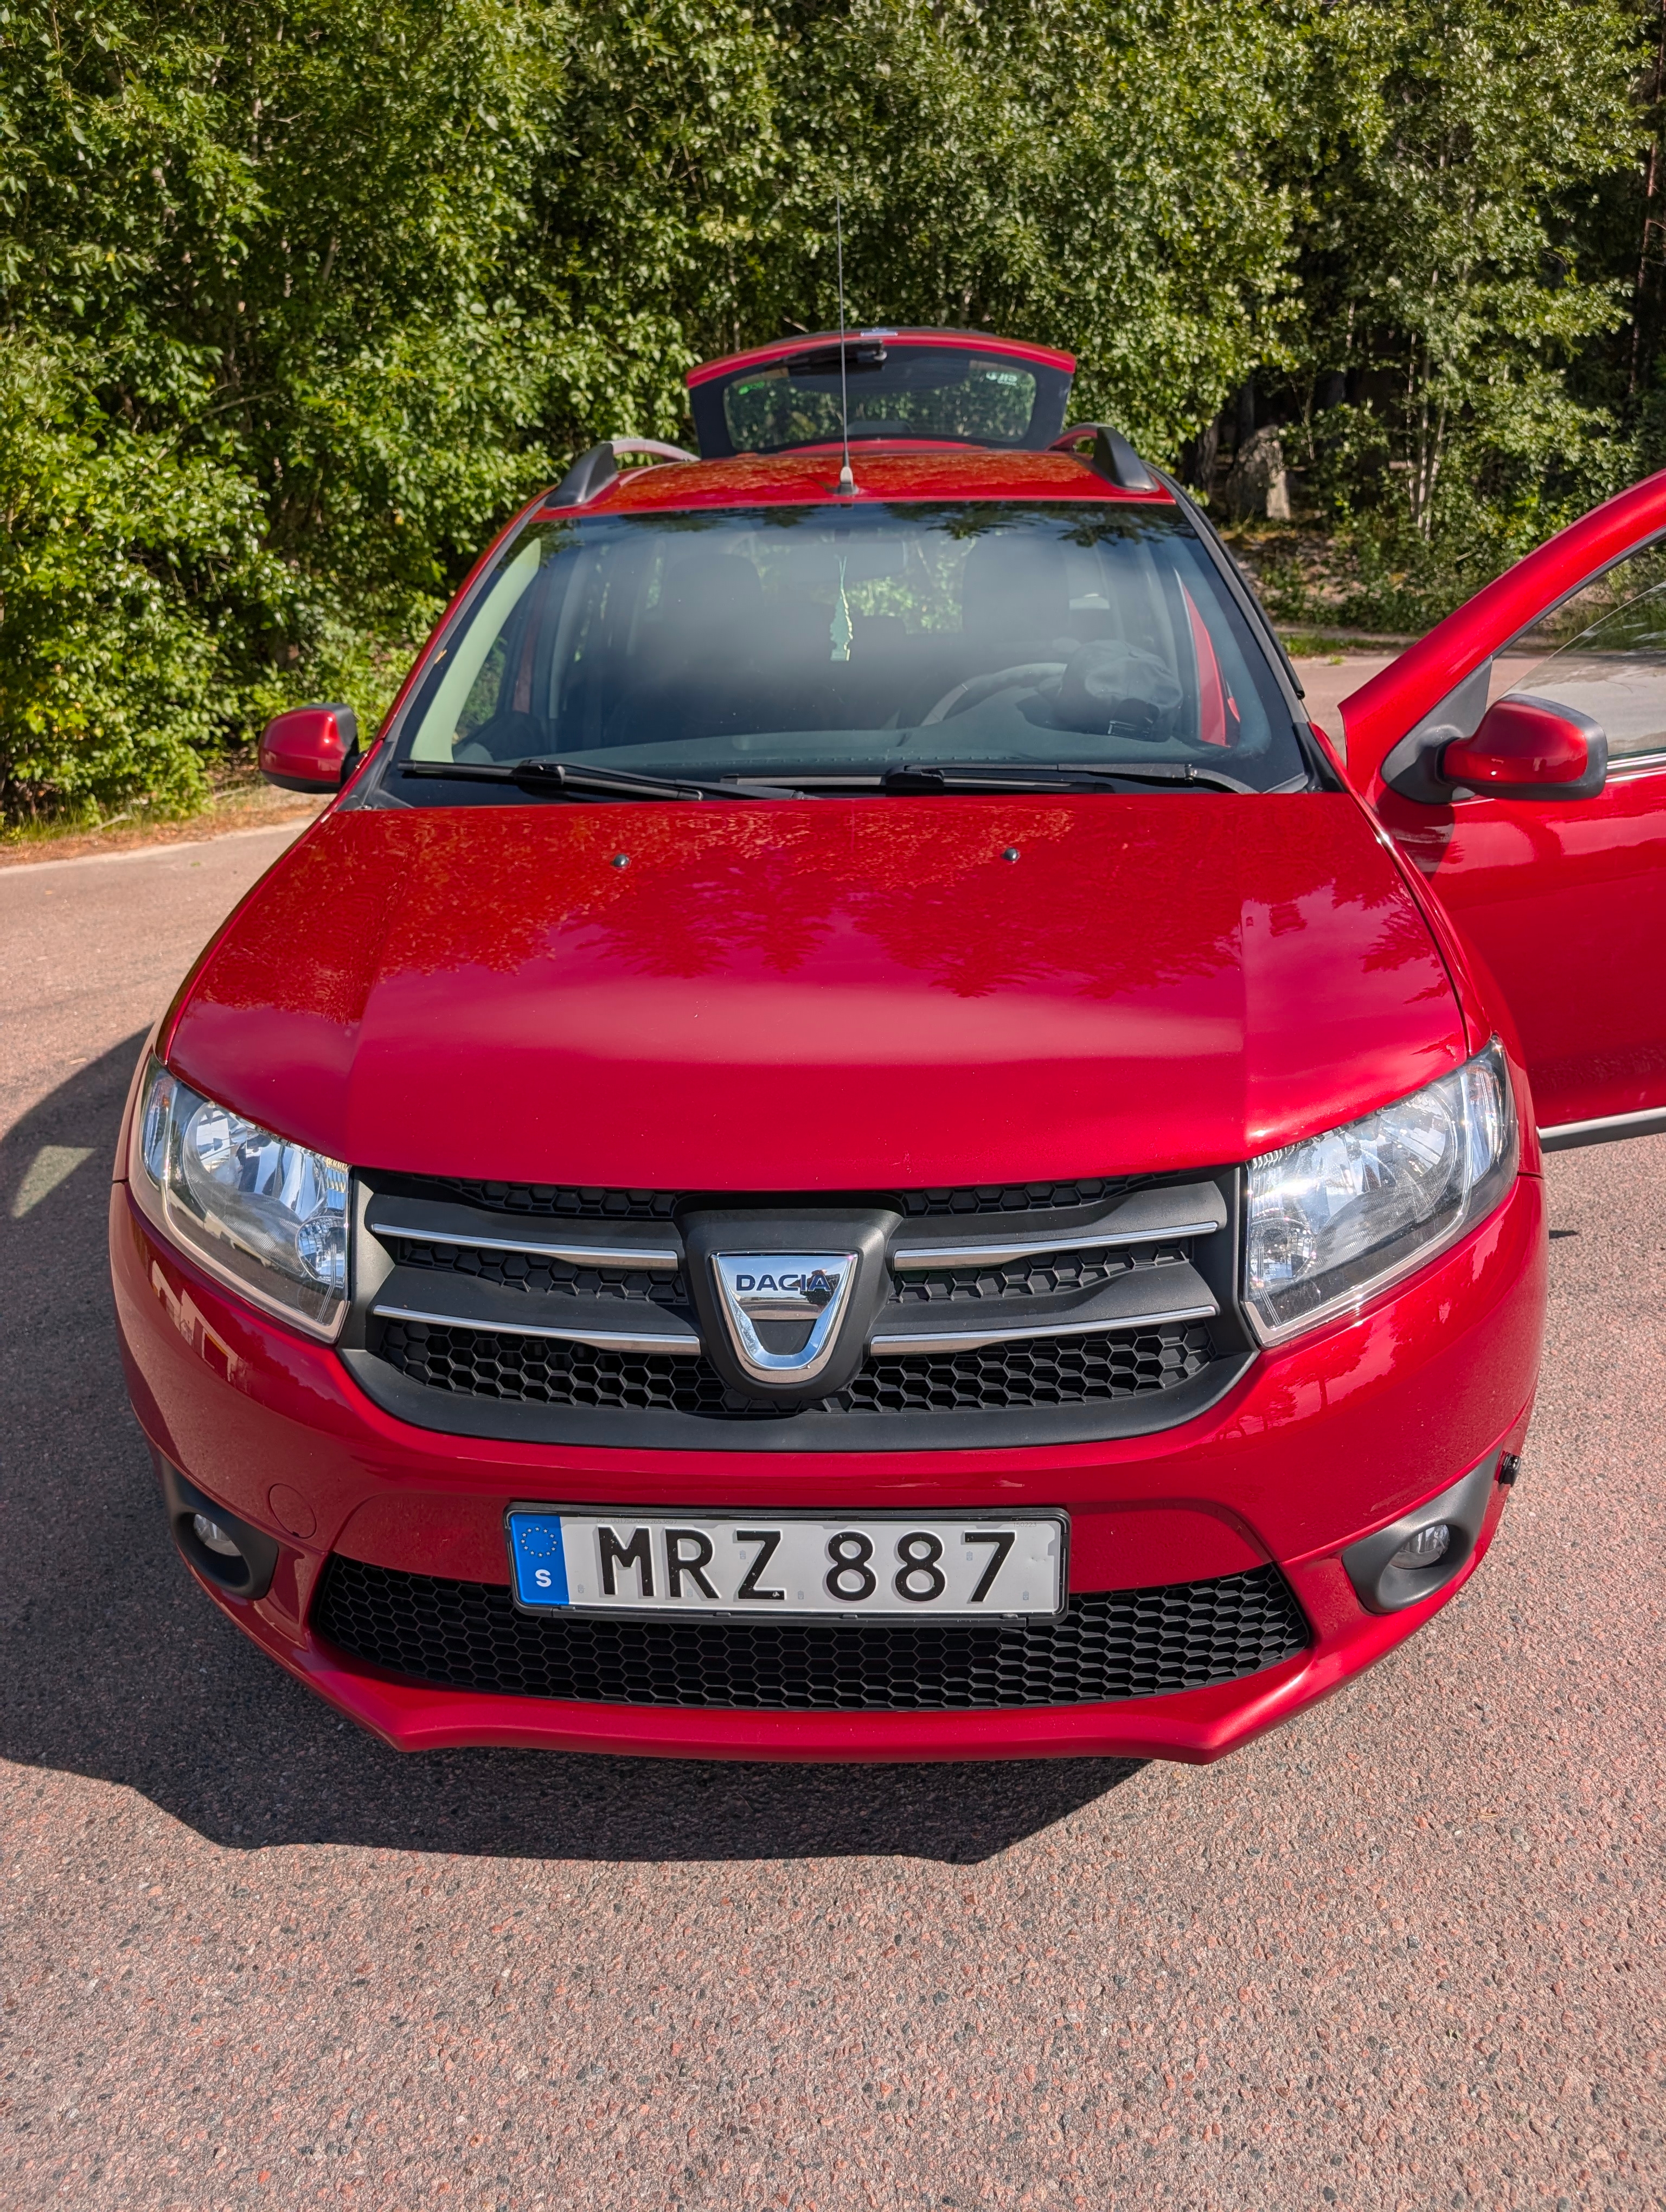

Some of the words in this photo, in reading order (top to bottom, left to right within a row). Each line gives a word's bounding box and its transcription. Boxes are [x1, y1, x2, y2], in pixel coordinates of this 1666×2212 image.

[736, 1274, 831, 1291] DACIA
[598, 1526, 785, 1600] MRZ
[826, 1531, 1015, 1603] 887
[535, 1569, 552, 1587] S
